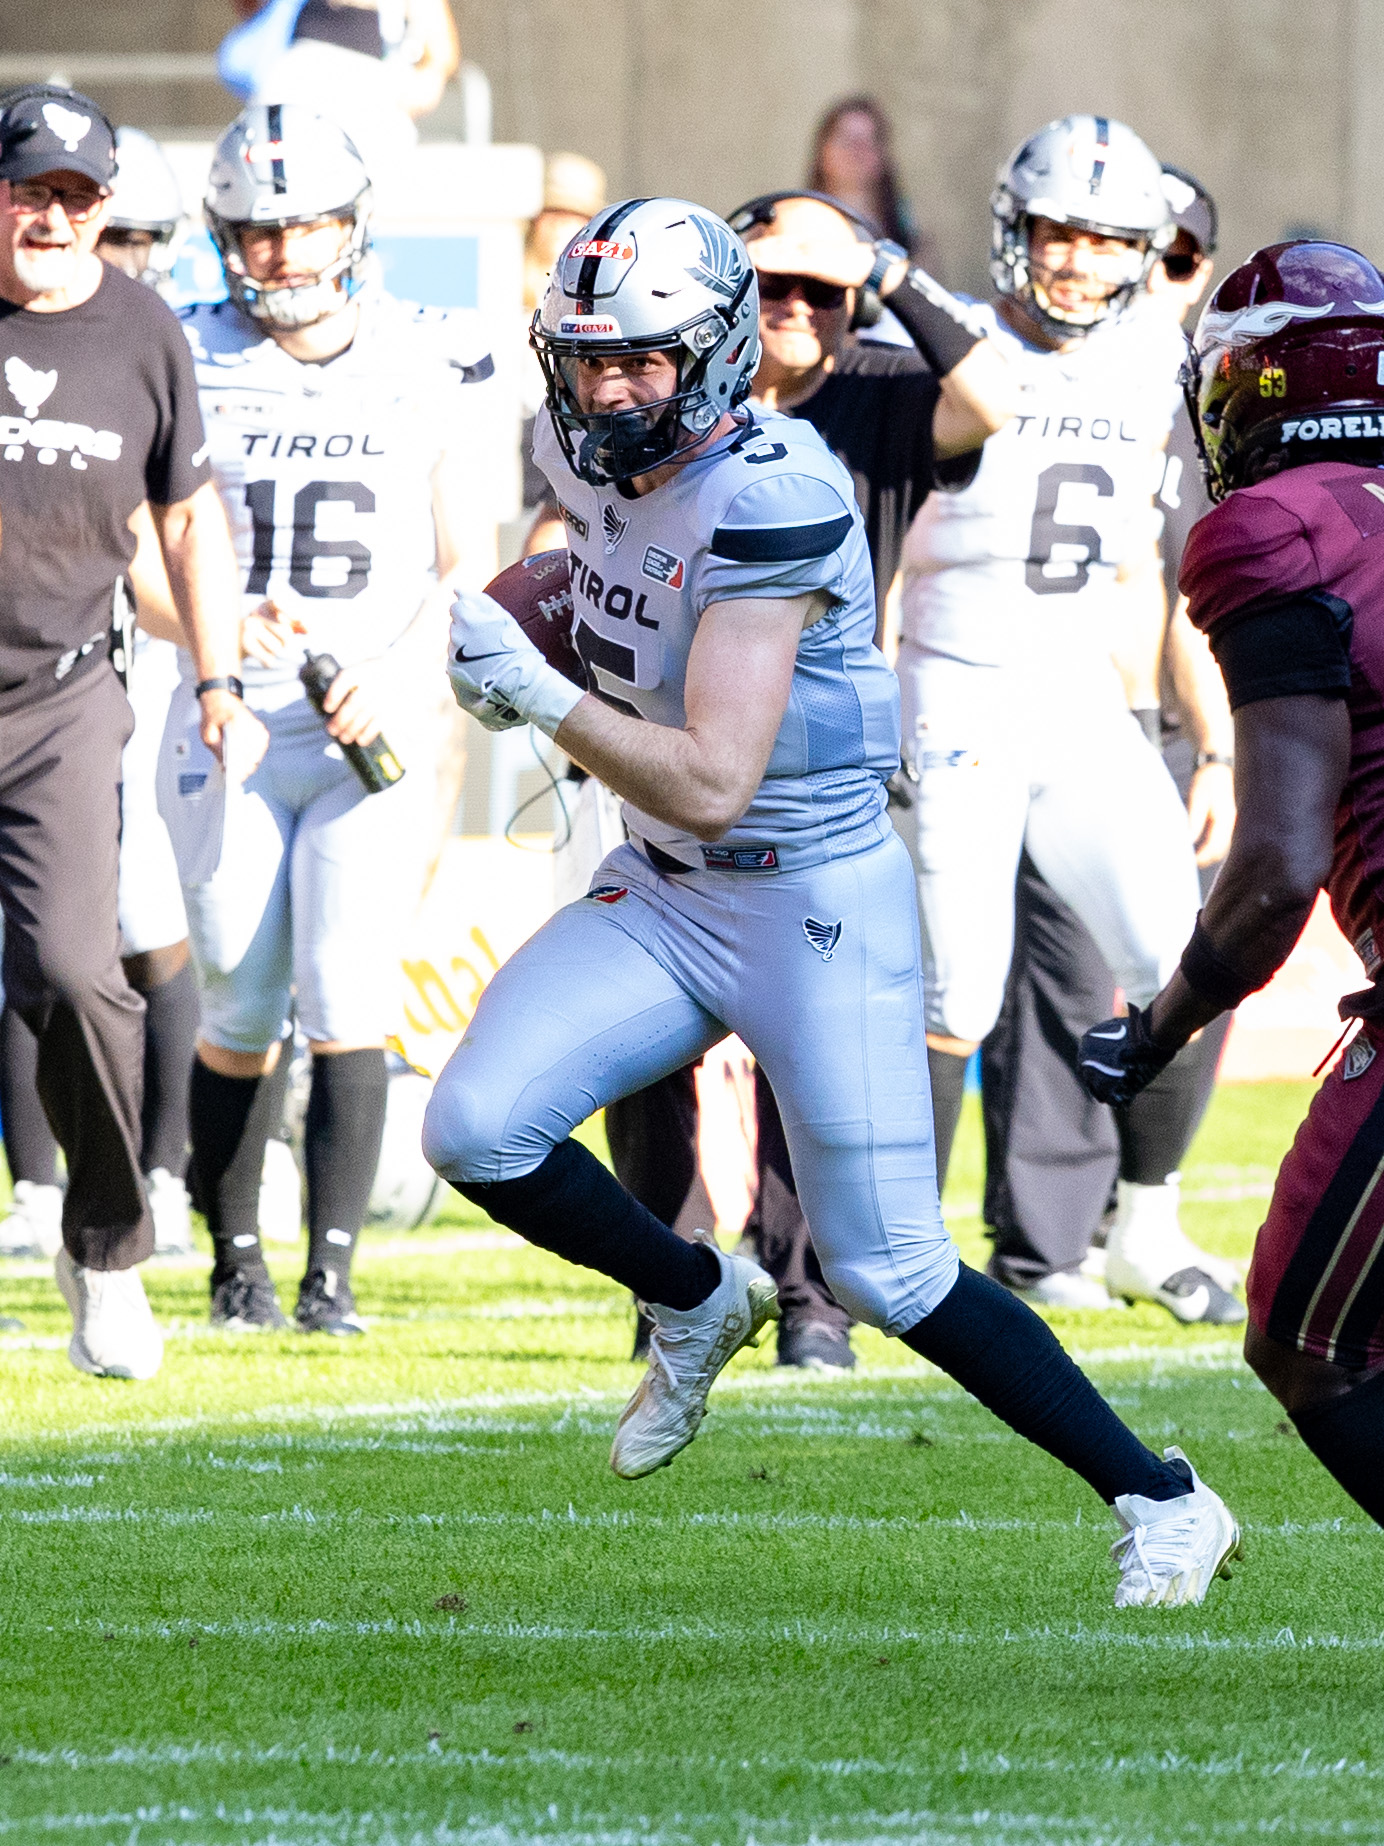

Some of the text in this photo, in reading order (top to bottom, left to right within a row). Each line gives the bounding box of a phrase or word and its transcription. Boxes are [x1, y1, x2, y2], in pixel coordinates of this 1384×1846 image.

[571, 241, 625, 260] GAZI
[242, 434, 385, 458] TIROL
[1014, 415, 1137, 442] TIROL
[244, 479, 375, 599] 16
[1024, 463, 1115, 595] 6
[570, 550, 660, 631] TIROL
